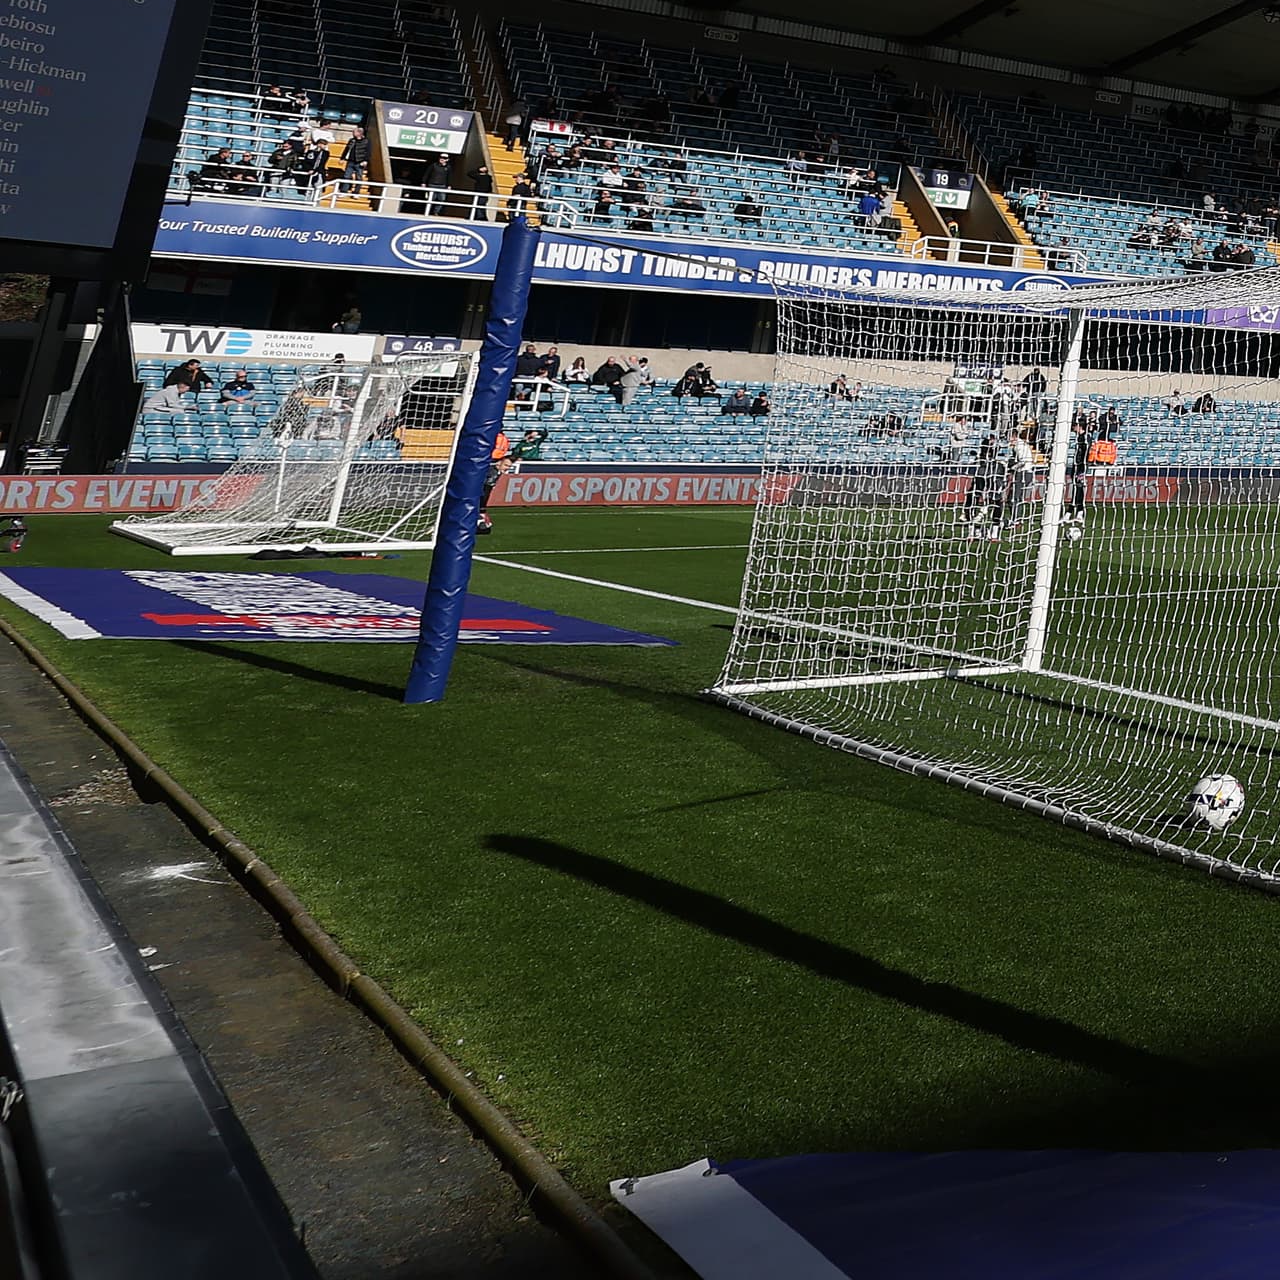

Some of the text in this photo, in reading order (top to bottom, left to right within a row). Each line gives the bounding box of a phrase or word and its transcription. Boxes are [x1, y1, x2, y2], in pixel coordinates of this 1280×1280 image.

[415, 110, 439, 125] 20
[936, 173, 949, 186] 19
[158, 218, 188, 231] our
[191, 220, 249, 235] Trusted
[250, 225, 310, 243] Building
[412, 231, 471, 247] SELHURST
[533, 242, 638, 273] LHURST
[264, 342, 314, 350] PLUMBING
[414, 341, 434, 352] 48
[0, 479, 218, 508] RTS EVENTS
[504, 477, 768, 503] FOR SPORTS EVENTS
[1091, 479, 1158, 501] EVENTS
